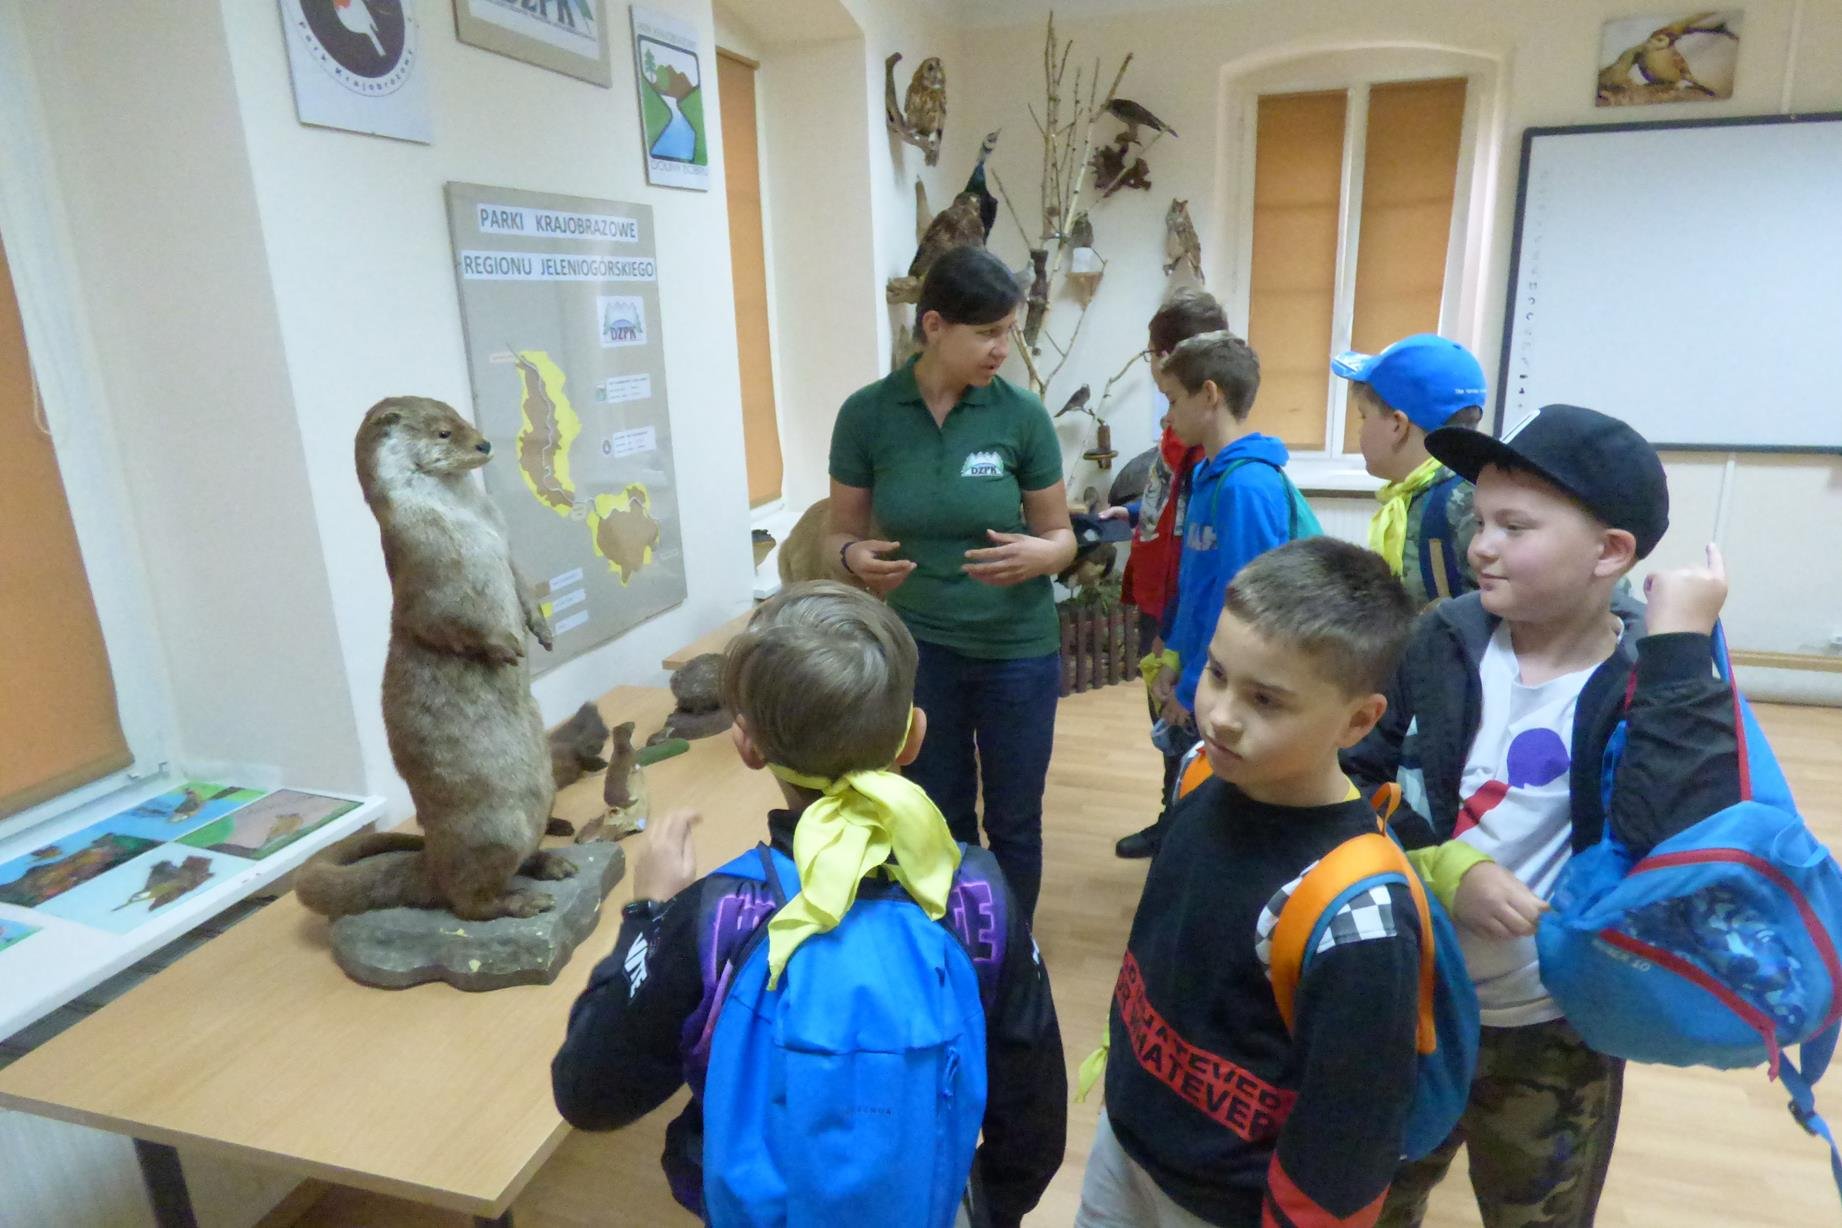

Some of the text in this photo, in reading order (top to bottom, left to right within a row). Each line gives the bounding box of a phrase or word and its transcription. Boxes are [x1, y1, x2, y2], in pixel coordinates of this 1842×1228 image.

[479, 208, 636, 239] PARKI KRAJOBRAZOWE
[463, 255, 533, 276] REGIONU
[610, 326, 637, 341] DZPK
[970, 466, 997, 475] DZPK
